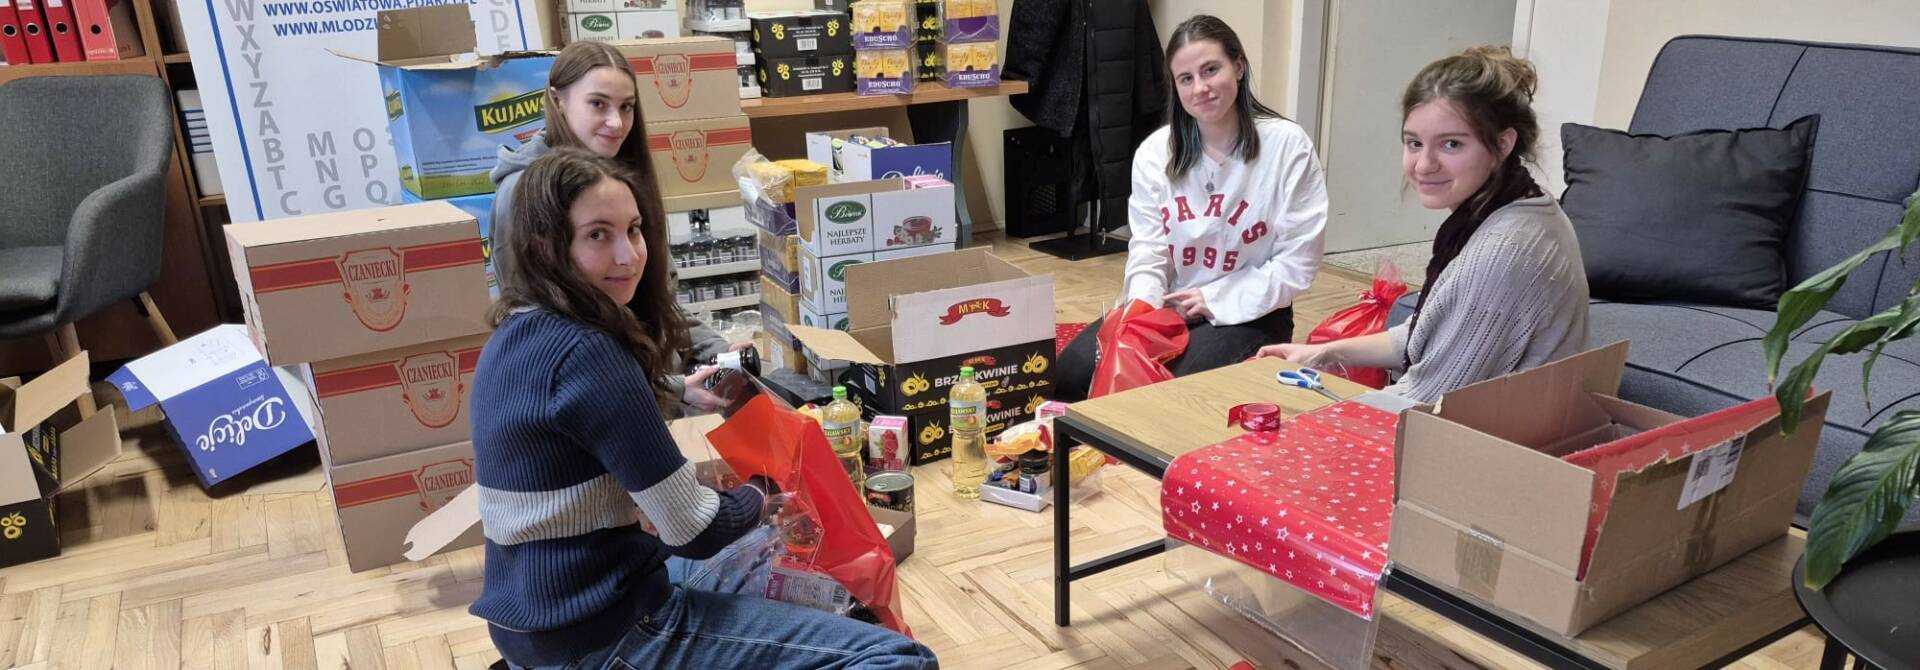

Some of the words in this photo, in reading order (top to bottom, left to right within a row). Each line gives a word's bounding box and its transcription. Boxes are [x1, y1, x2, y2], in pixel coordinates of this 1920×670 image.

[1160, 194, 1268, 244] PARIS
[827, 228, 866, 239] NAJLEPSZE
[830, 237, 865, 246] HERBATY
[1168, 244, 1239, 272] 1995
[349, 260, 397, 282] CZANIECKI
[406, 363, 453, 384] CZANIECKI
[934, 364, 1019, 388] BRZKWINIE
[196, 396, 286, 452] Delicje
[424, 470, 469, 492] CZANIECKI
